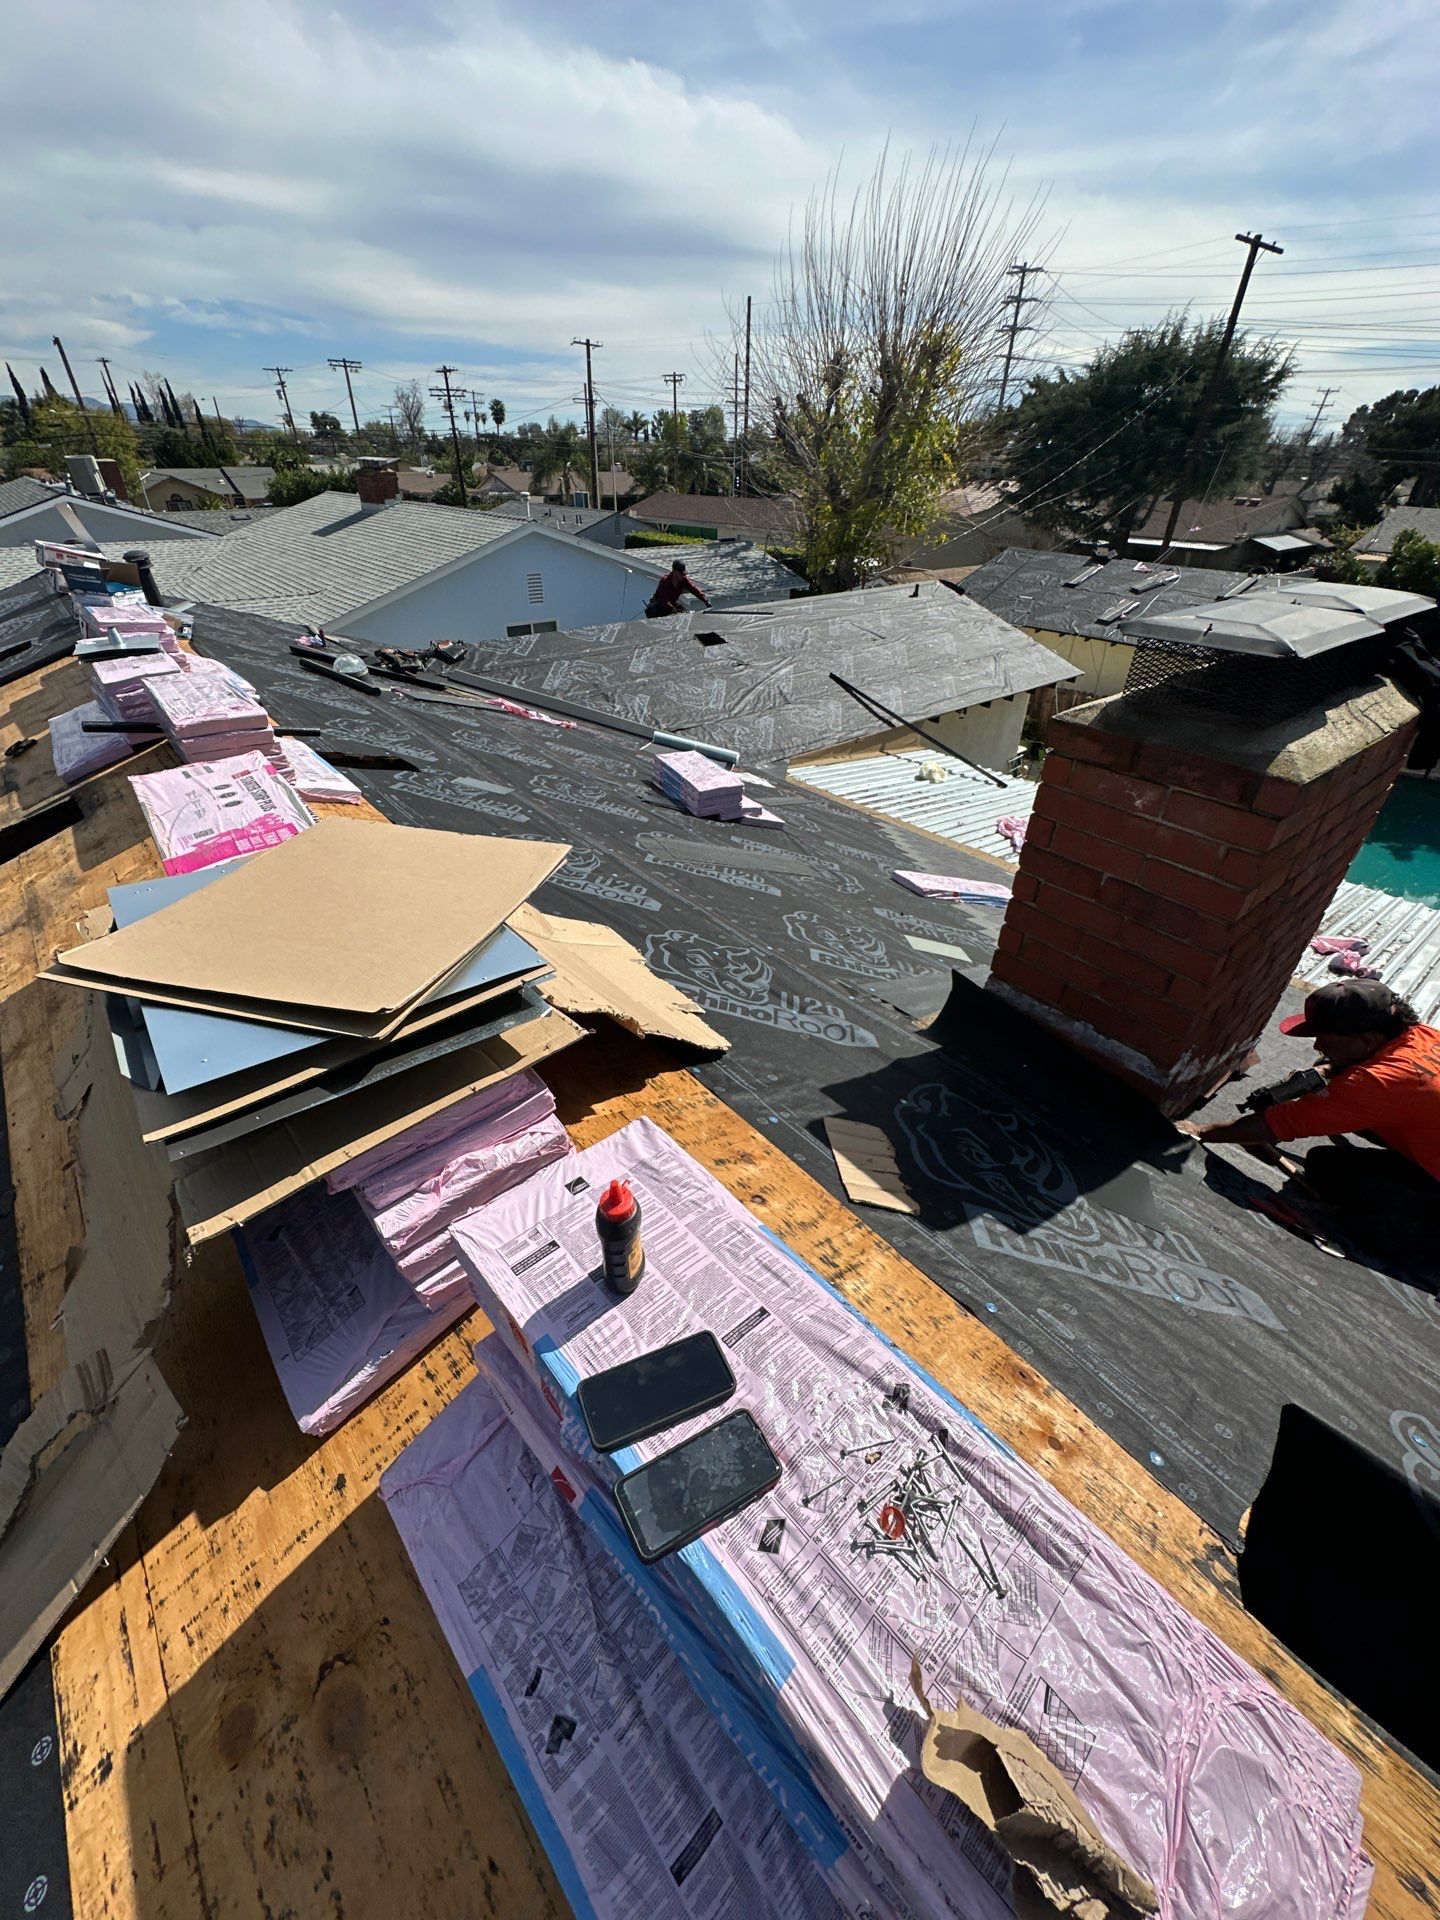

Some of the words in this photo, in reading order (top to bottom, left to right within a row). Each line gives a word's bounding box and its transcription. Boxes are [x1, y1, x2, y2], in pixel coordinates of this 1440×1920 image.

[550, 875, 652, 907] noRoof
[594, 875, 648, 895] U20
[780, 991, 846, 1020] U20
